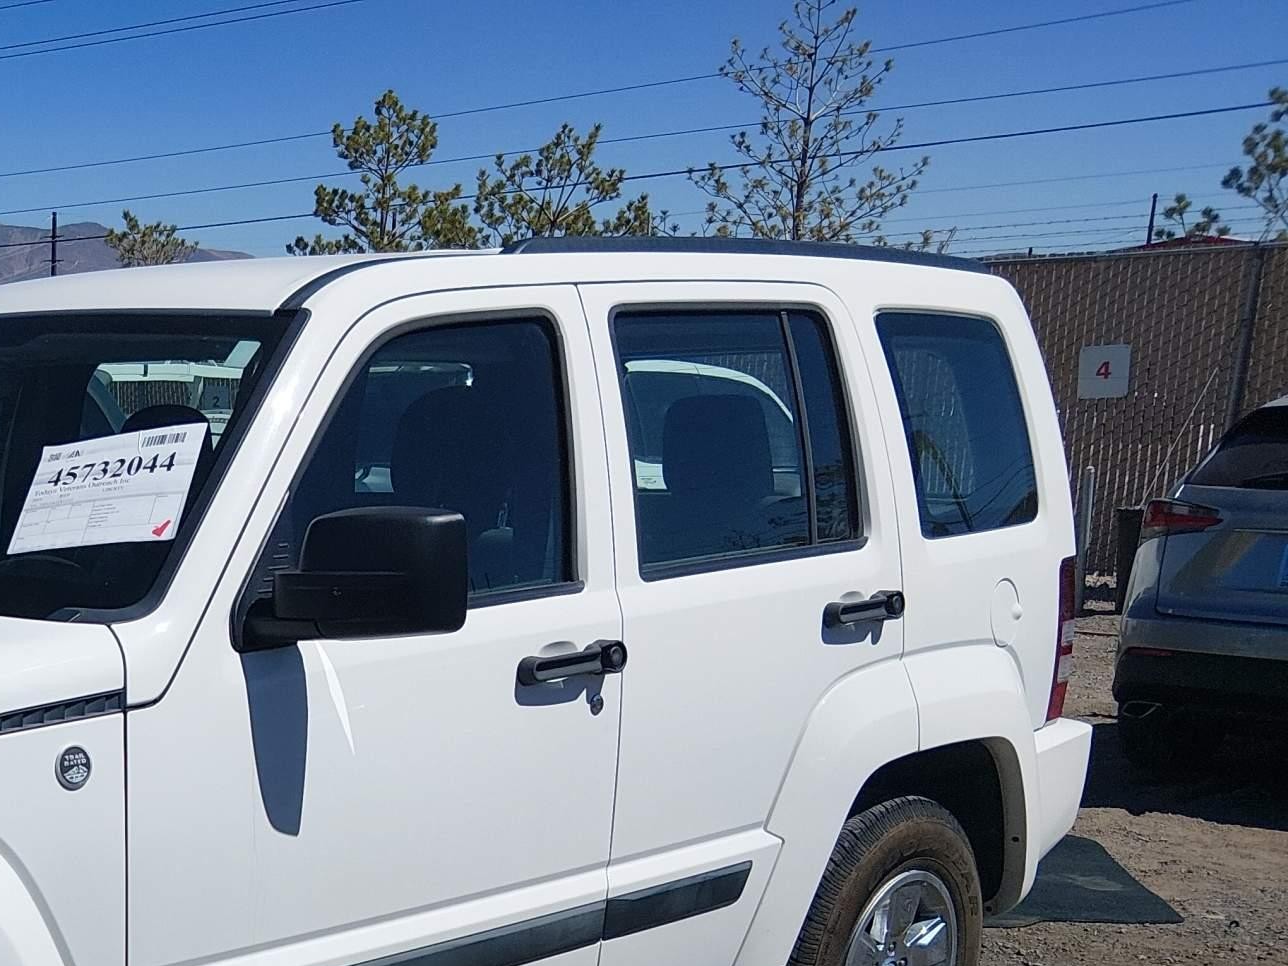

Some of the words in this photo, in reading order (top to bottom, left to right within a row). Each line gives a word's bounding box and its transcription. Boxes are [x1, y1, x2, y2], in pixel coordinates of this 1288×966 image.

[1095, 361, 1112, 380] 4
[212, 396, 220, 408] 2
[47, 451, 177, 487] 45732044
